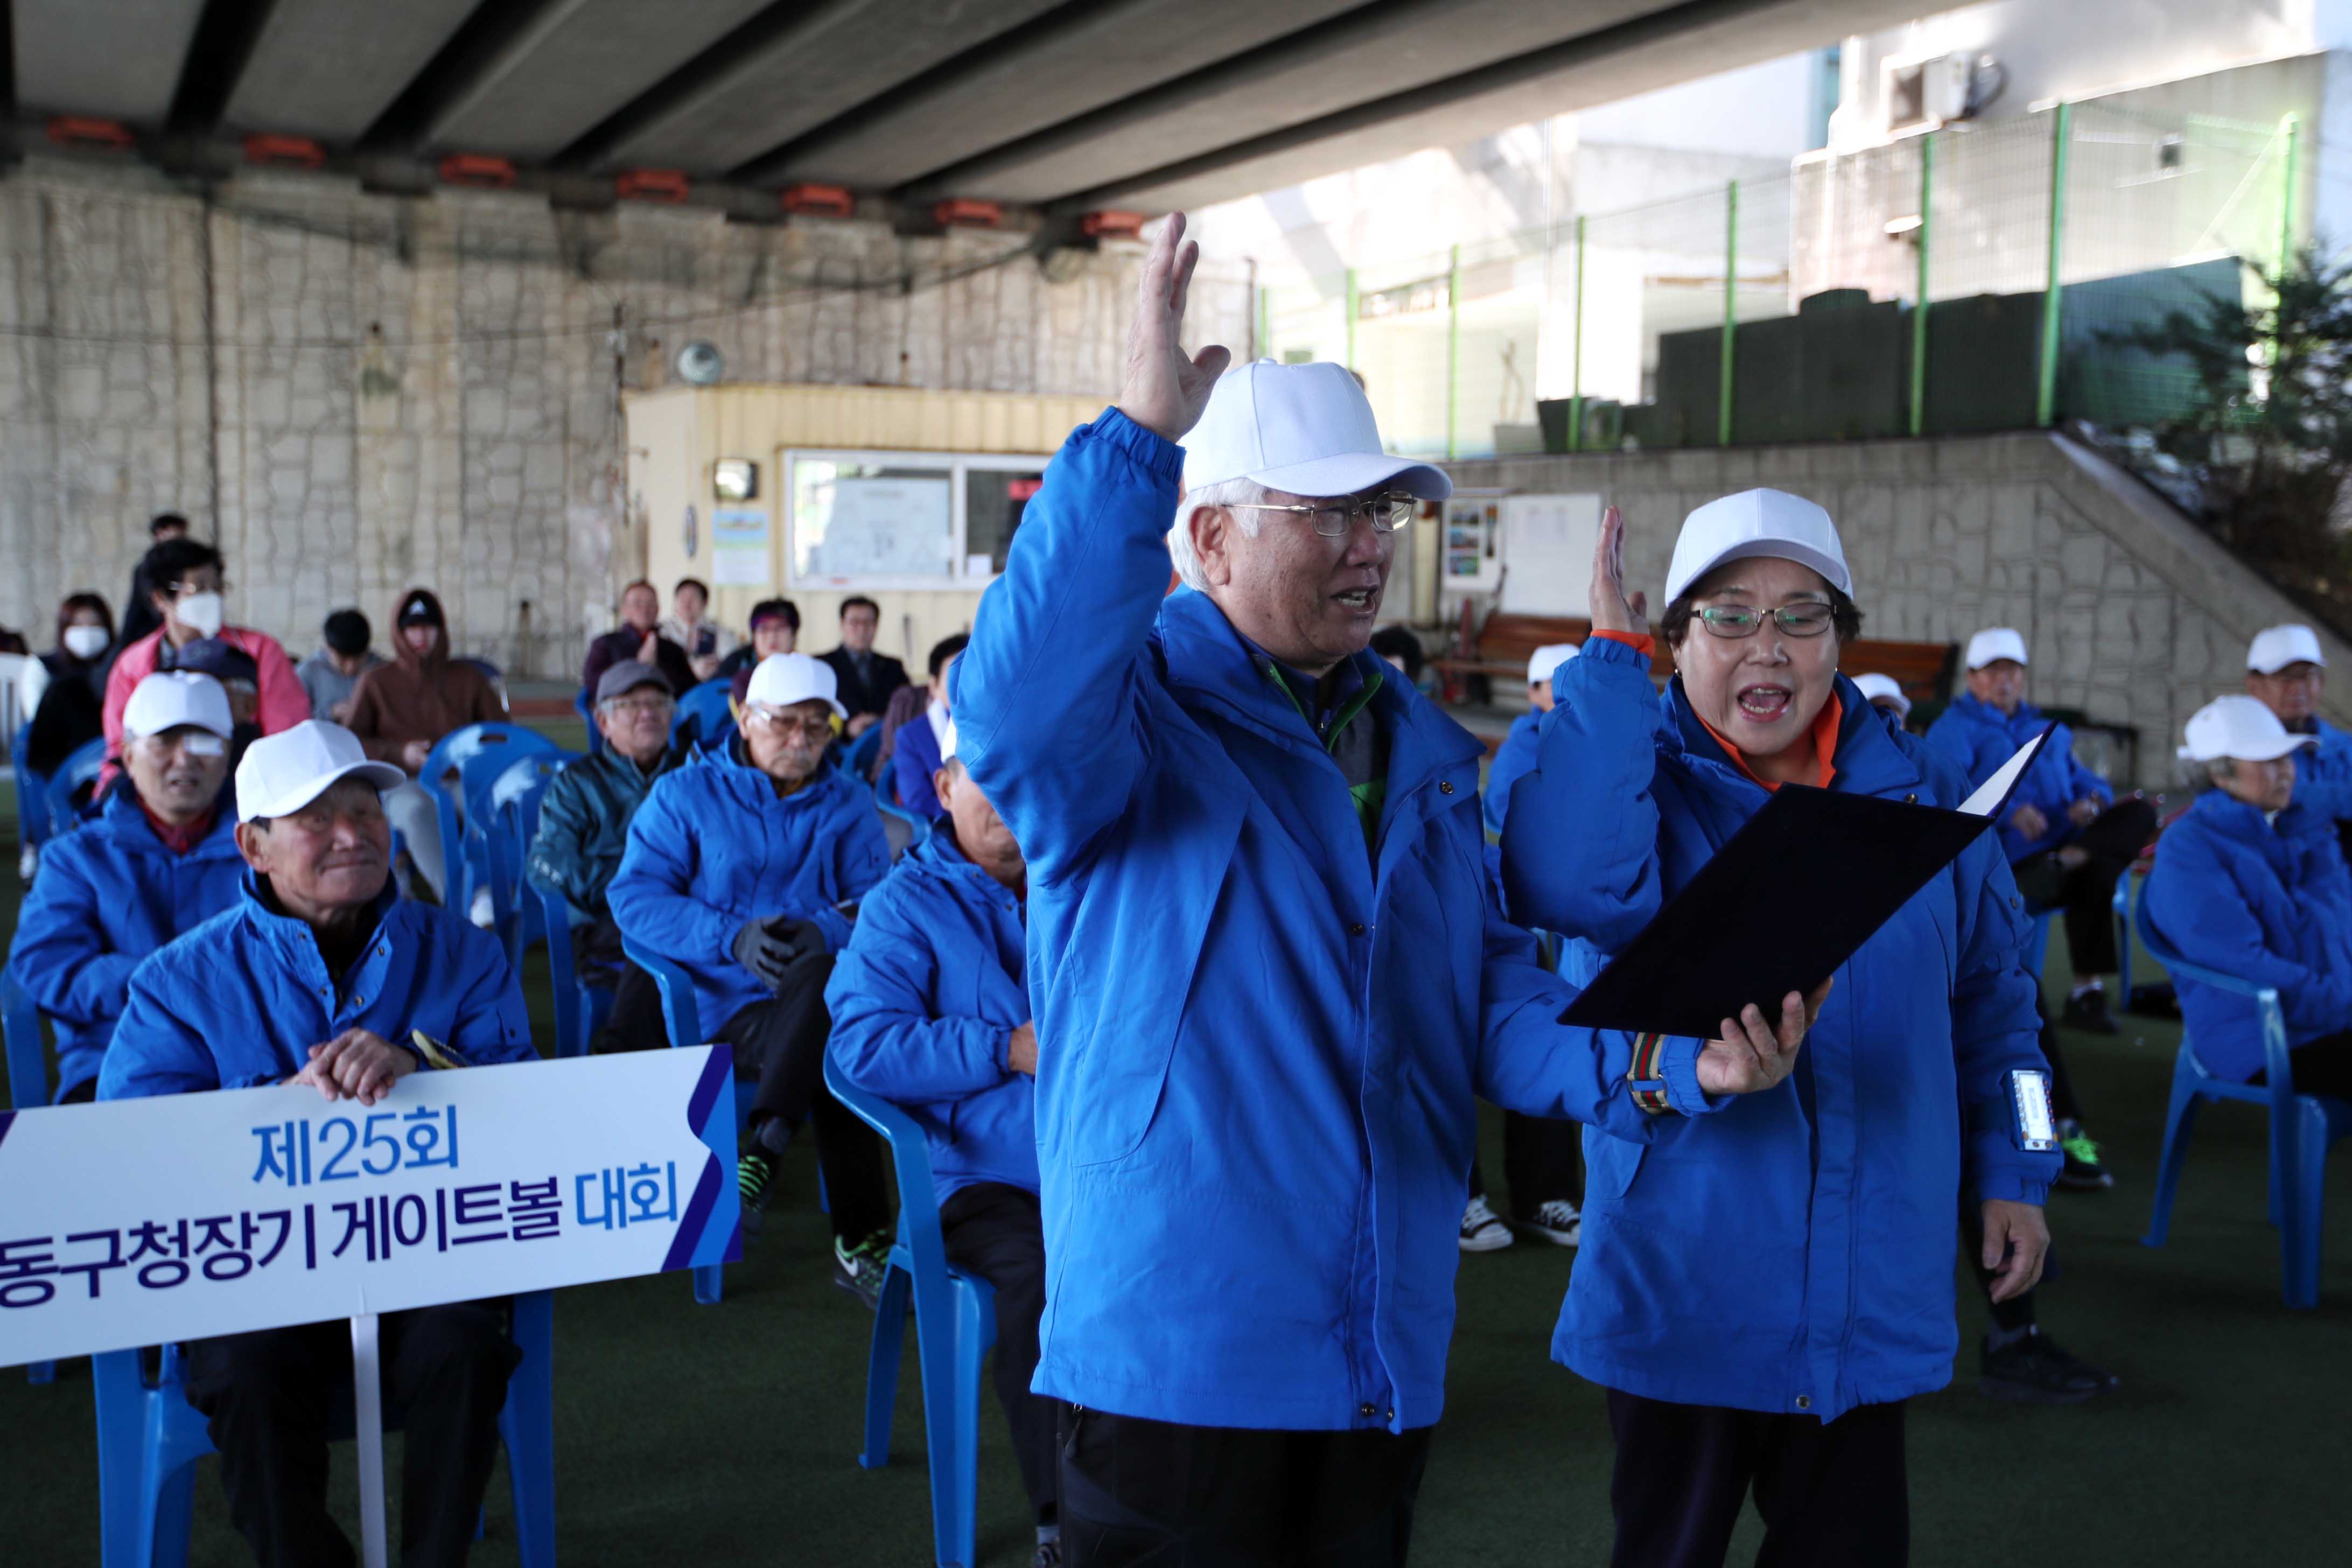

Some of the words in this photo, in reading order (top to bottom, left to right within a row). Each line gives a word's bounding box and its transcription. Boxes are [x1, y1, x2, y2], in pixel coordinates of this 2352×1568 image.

[251, 1105, 459, 1187] 제25회
[0, 1204, 317, 1309] 동구청장기
[332, 1177, 562, 1262] 게이트볼
[576, 1161, 678, 1231] 대회
